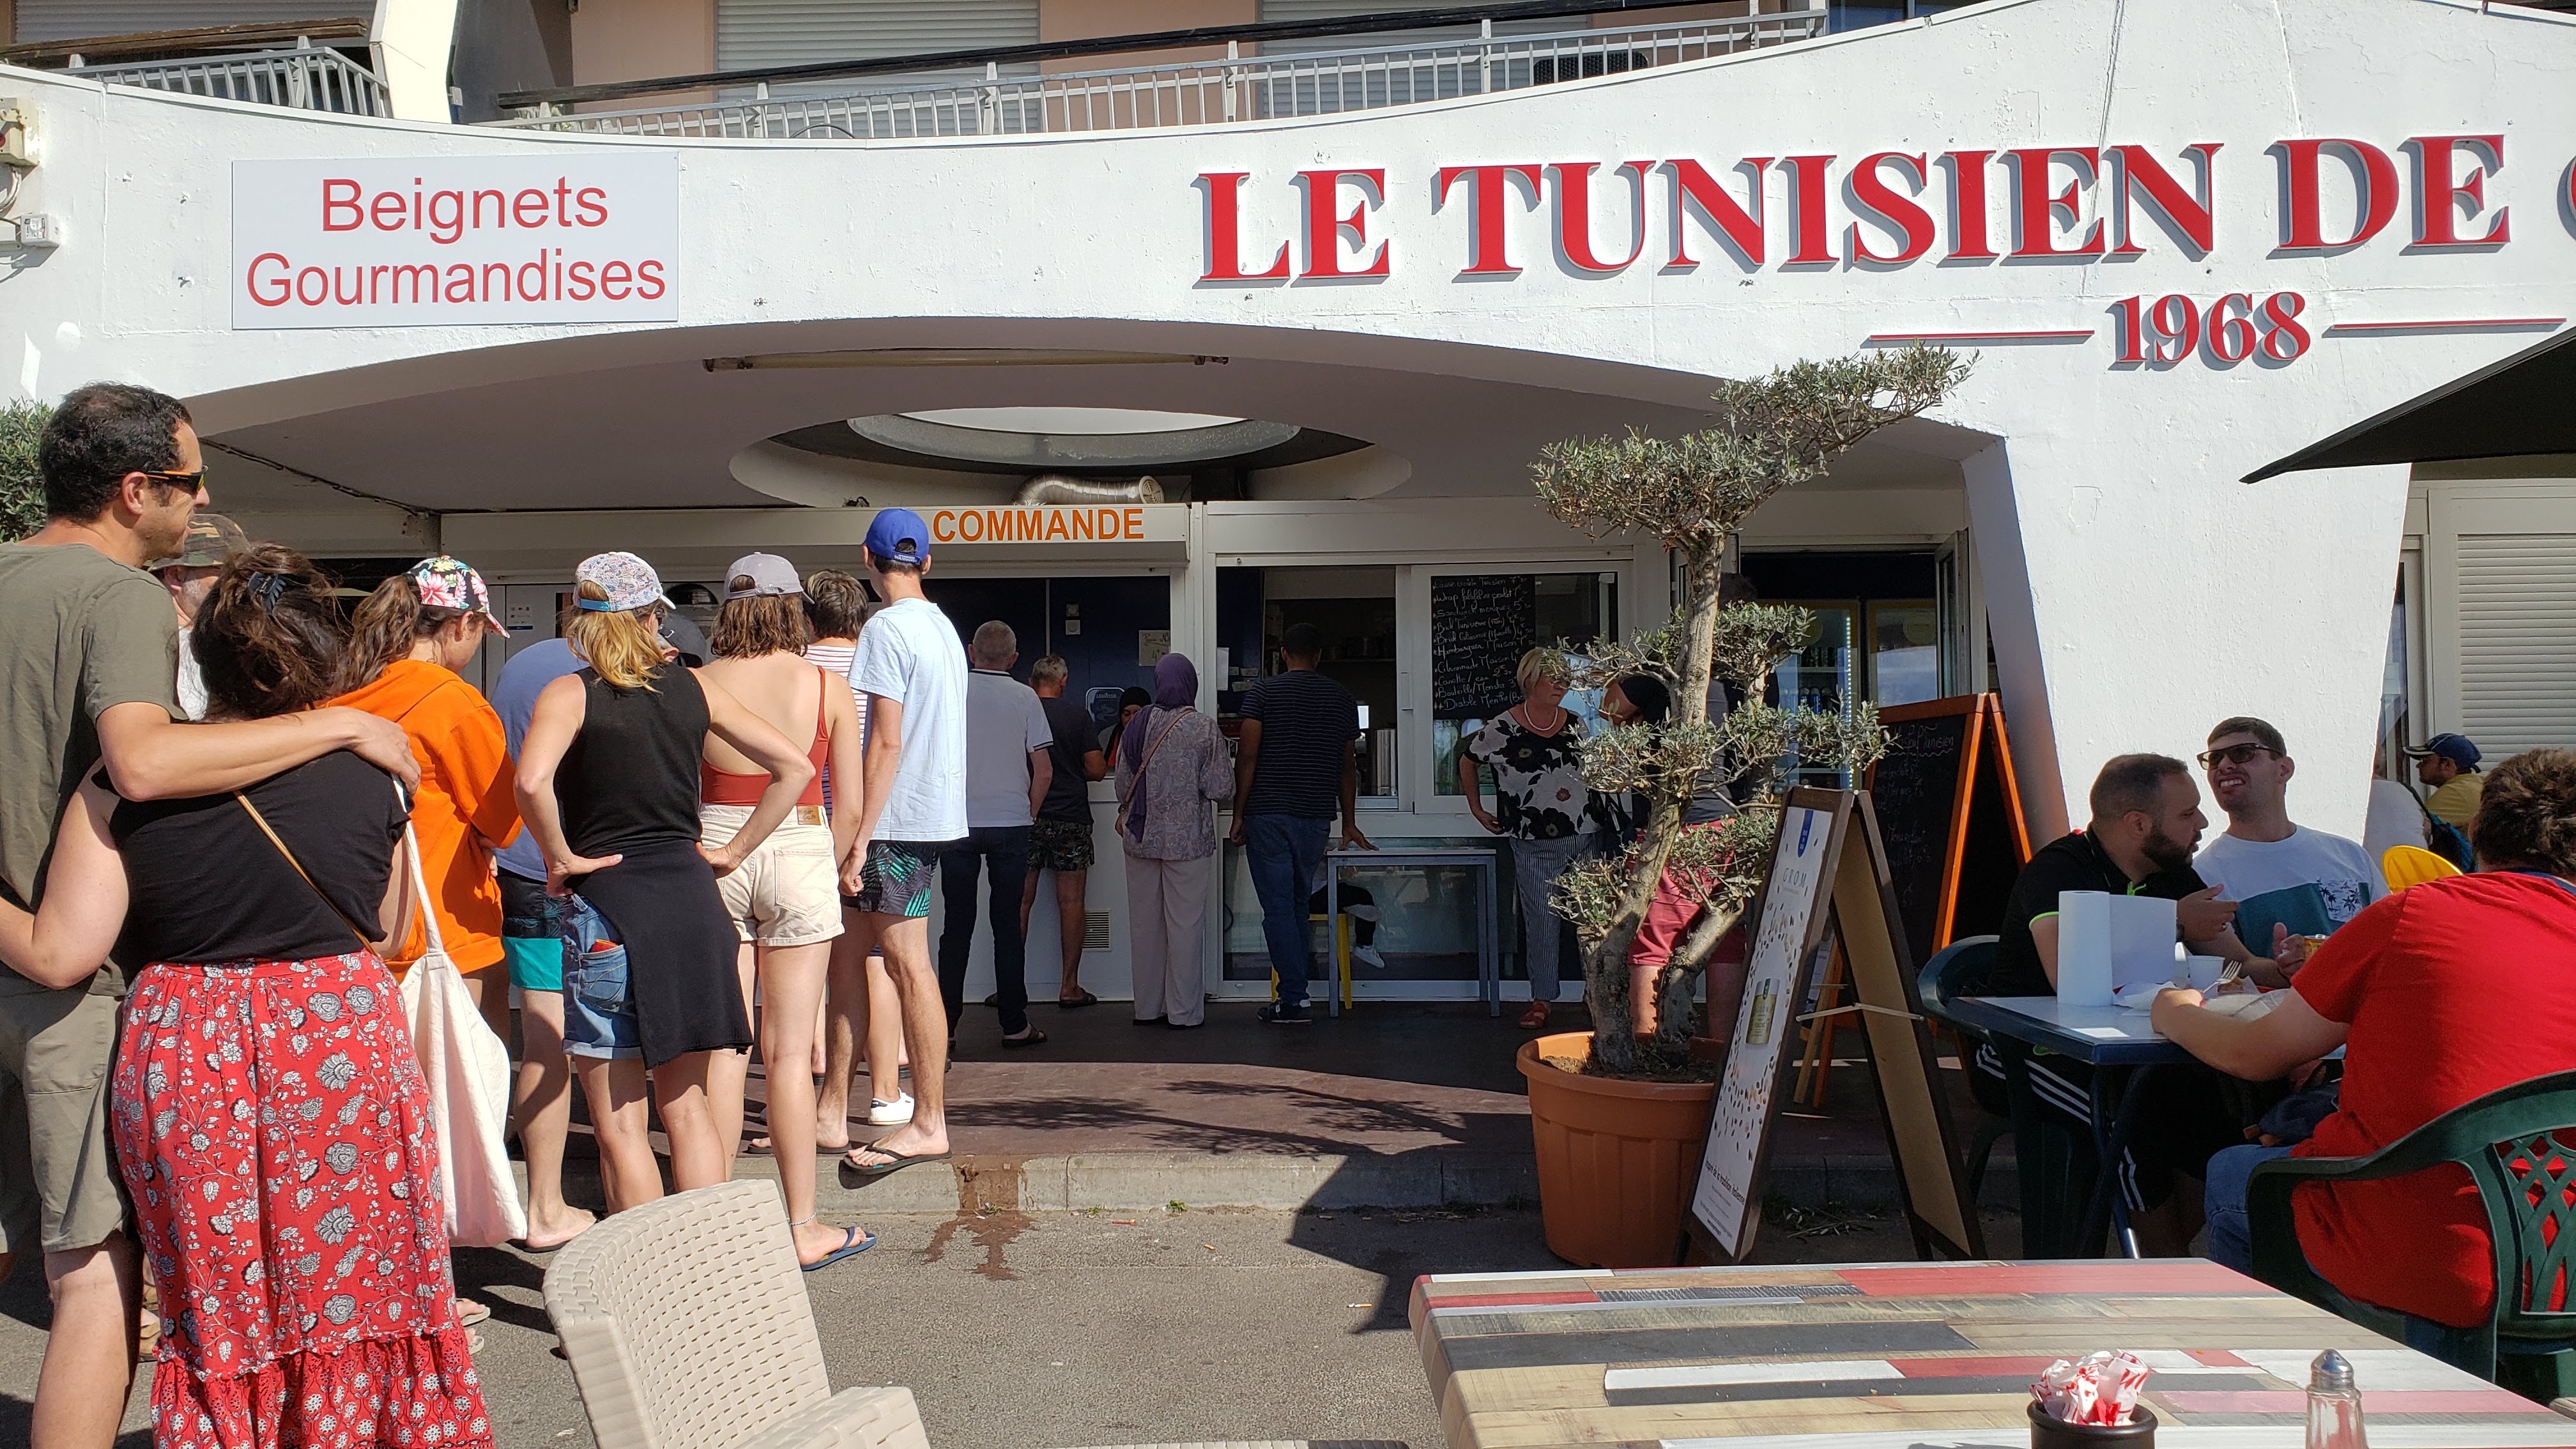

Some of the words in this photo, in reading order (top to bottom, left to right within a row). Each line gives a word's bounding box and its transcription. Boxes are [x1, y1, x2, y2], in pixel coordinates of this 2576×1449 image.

[322, 176, 609, 245] Beignets
[1199, 168, 1390, 281] LE
[1439, 142, 2225, 275] TUNISIEN
[2274, 134, 2511, 250] DE
[247, 247, 666, 307] Gourmandises
[2115, 291, 2312, 364] 1968
[933, 508, 1145, 542] COMMANDE
[1436, 592, 1459, 608] Wrap
[1782, 867, 1807, 888] GROM
